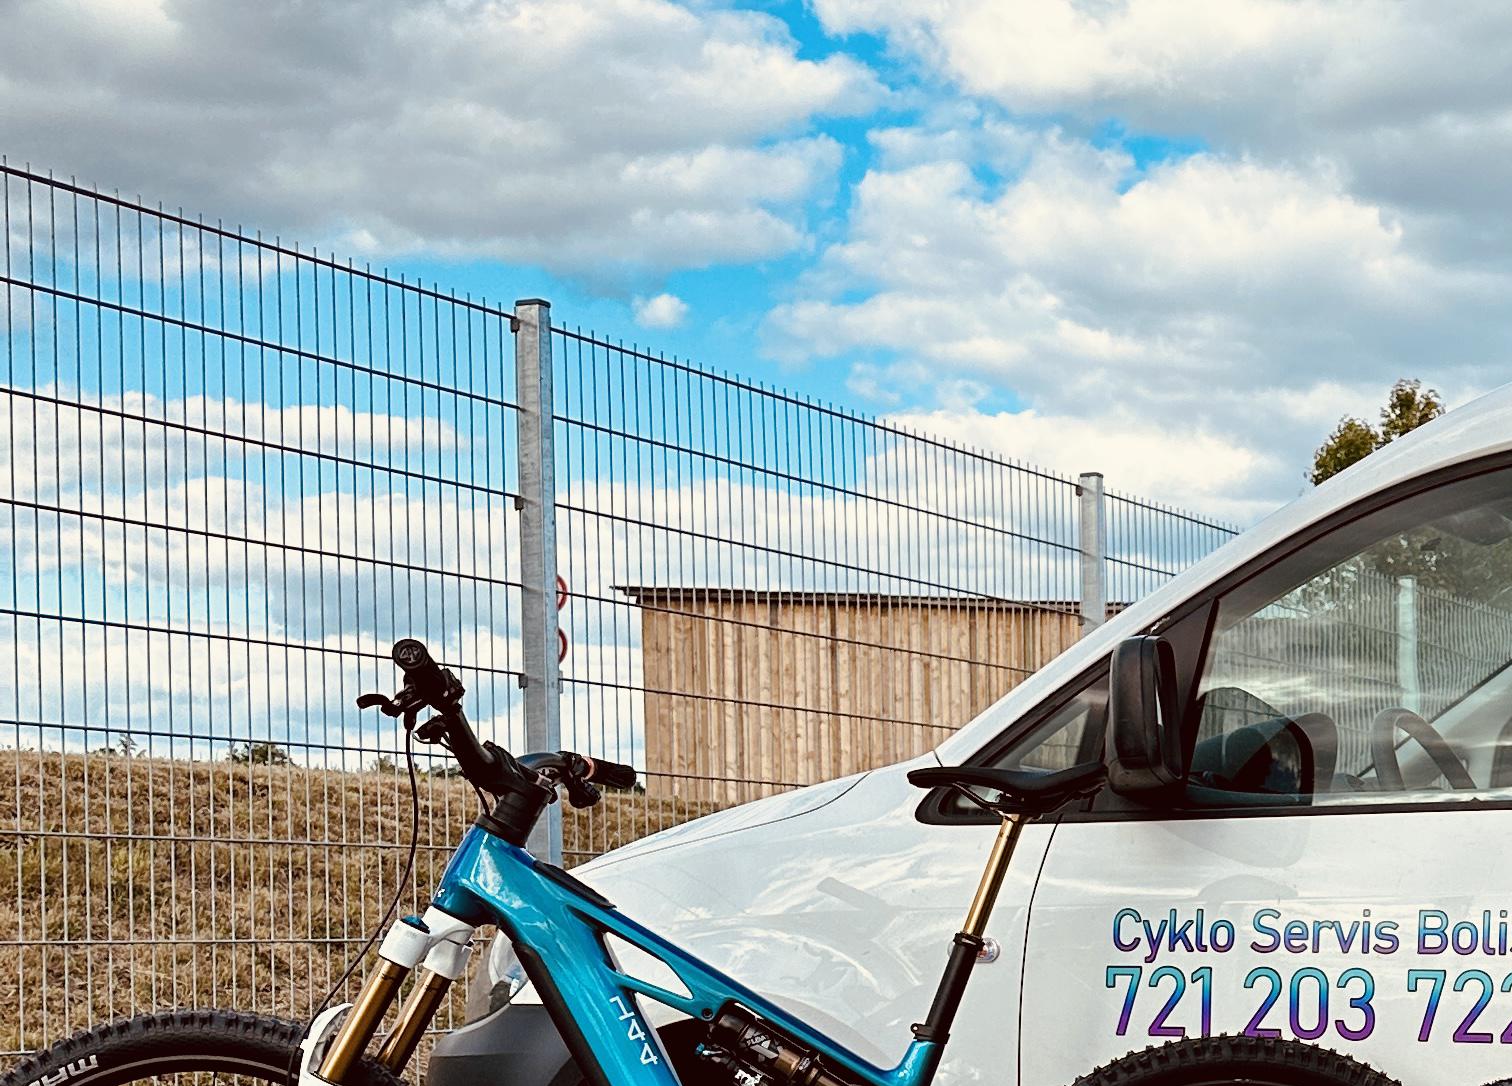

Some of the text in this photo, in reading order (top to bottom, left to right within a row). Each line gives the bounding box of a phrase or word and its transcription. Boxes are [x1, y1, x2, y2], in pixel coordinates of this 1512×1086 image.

[1113, 908, 1235, 963] Cyklo
[1250, 909, 1399, 954] Servis
[1105, 965, 1213, 1037] 721
[1243, 966, 1376, 1041] 203
